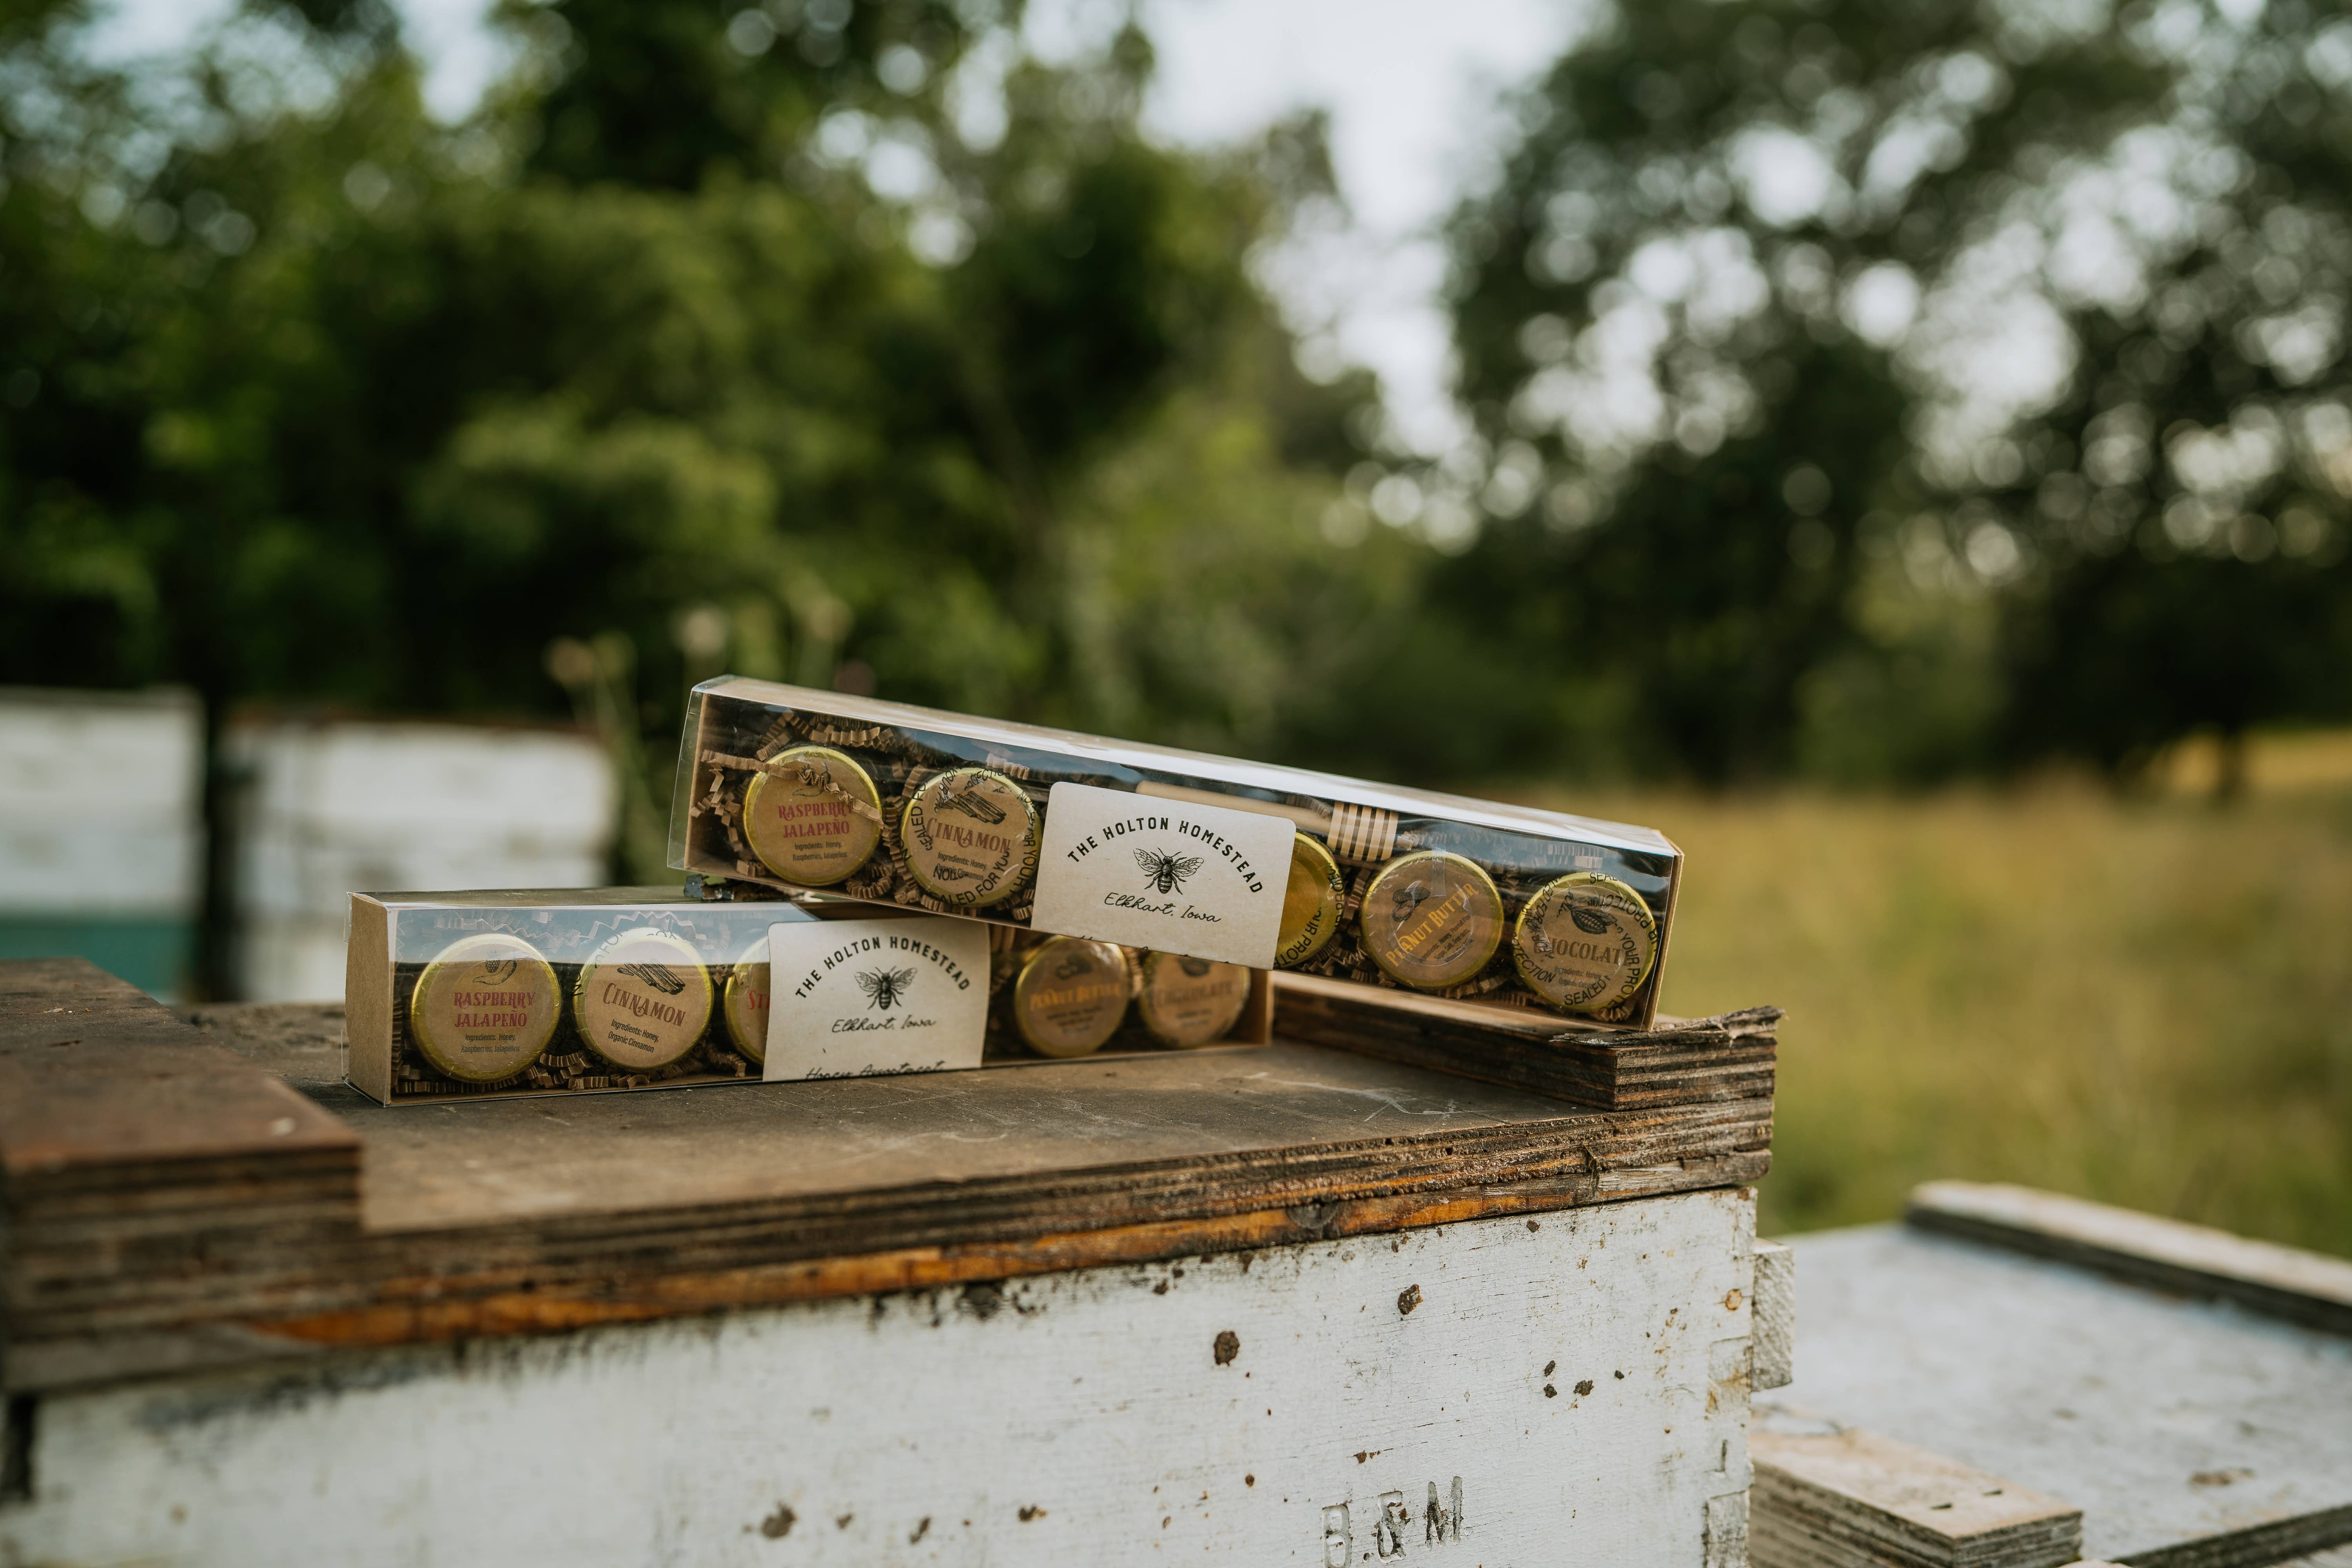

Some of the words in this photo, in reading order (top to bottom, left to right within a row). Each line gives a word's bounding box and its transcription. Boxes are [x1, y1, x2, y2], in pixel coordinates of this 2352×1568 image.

[778, 801, 852, 821] RASPBERRY
[783, 818, 850, 838] JALAPEÑO
[926, 817, 1011, 853] CINNAMON
[793, 853, 822, 861] Raspberries,
[824, 851, 848, 859] Jalapeños
[795, 842, 823, 851] Ingredients:
[1067, 836, 1098, 862] THE
[1102, 817, 1169, 840] HOLTON
[1178, 820, 1263, 894] HOMESTEAD
[937, 851, 969, 866] Ingredients:
[970, 859, 987, 871] Honey,
[975, 872, 1000, 897] FOR
[1180, 905, 1221, 922] Iowa
[1620, 933, 1640, 965] YOUR
[795, 969, 822, 998] THE
[824, 936, 881, 970] HOLTON
[890, 936, 970, 990] HOMESTEAD
[454, 992, 536, 1009] RASPBERRY
[1564, 979, 1607, 1005] SEALED
[603, 982, 686, 1027] CINNAMON
[454, 1010, 528, 1027] JALAPEÑO
[901, 1014, 937, 1029] Iowa
[465, 1034, 496, 1043] Ingredients:
[499, 1033, 516, 1042] Honey,
[611, 1019, 642, 1036] Ingredients:
[642, 1029, 659, 1043] Honey,
[461, 1045, 493, 1054] Raspberries,
[494, 1045, 520, 1054] Jalapeños
[608, 1031, 628, 1044] Organic
[628, 1038, 654, 1053] Cinnamon
